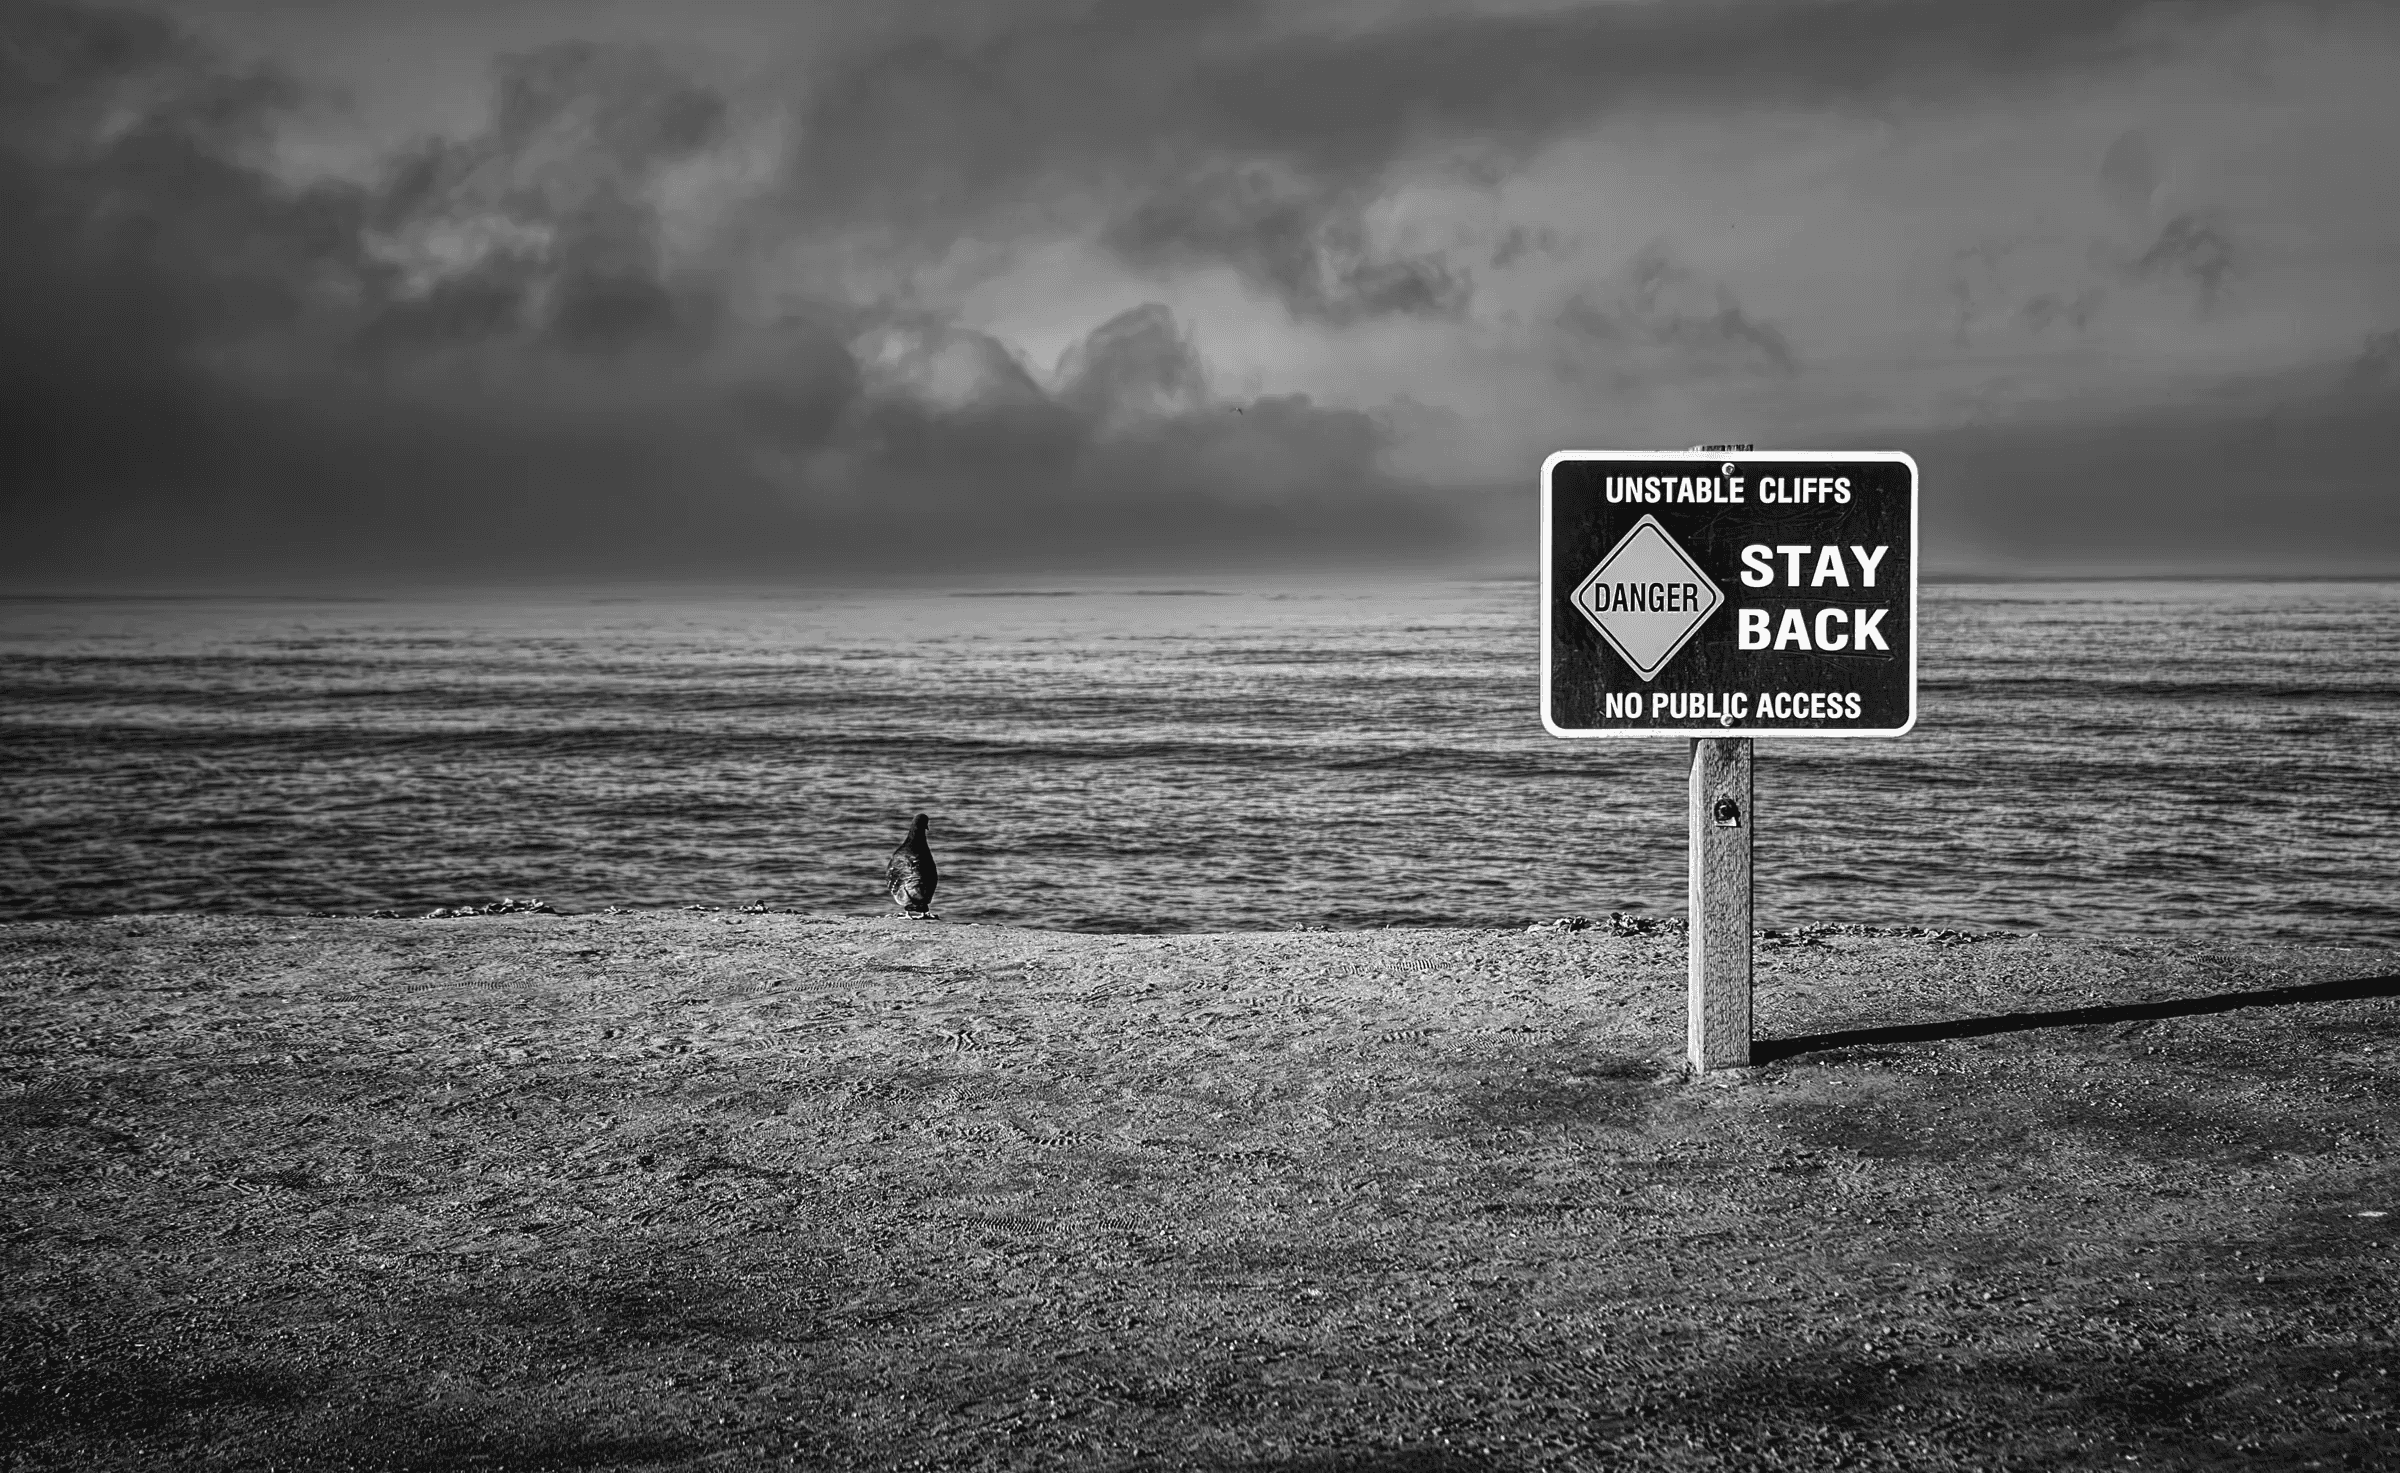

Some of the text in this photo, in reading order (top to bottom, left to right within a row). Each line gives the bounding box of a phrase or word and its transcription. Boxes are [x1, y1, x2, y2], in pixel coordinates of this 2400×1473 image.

[1606, 477, 1851, 503] UNSTABLE CLIFFS
[1740, 544, 1889, 588] STAY
[1595, 582, 1699, 612] DANGER
[1738, 608, 1890, 650] BACK
[1605, 692, 1862, 719] NO PUBLIC ACCESS
